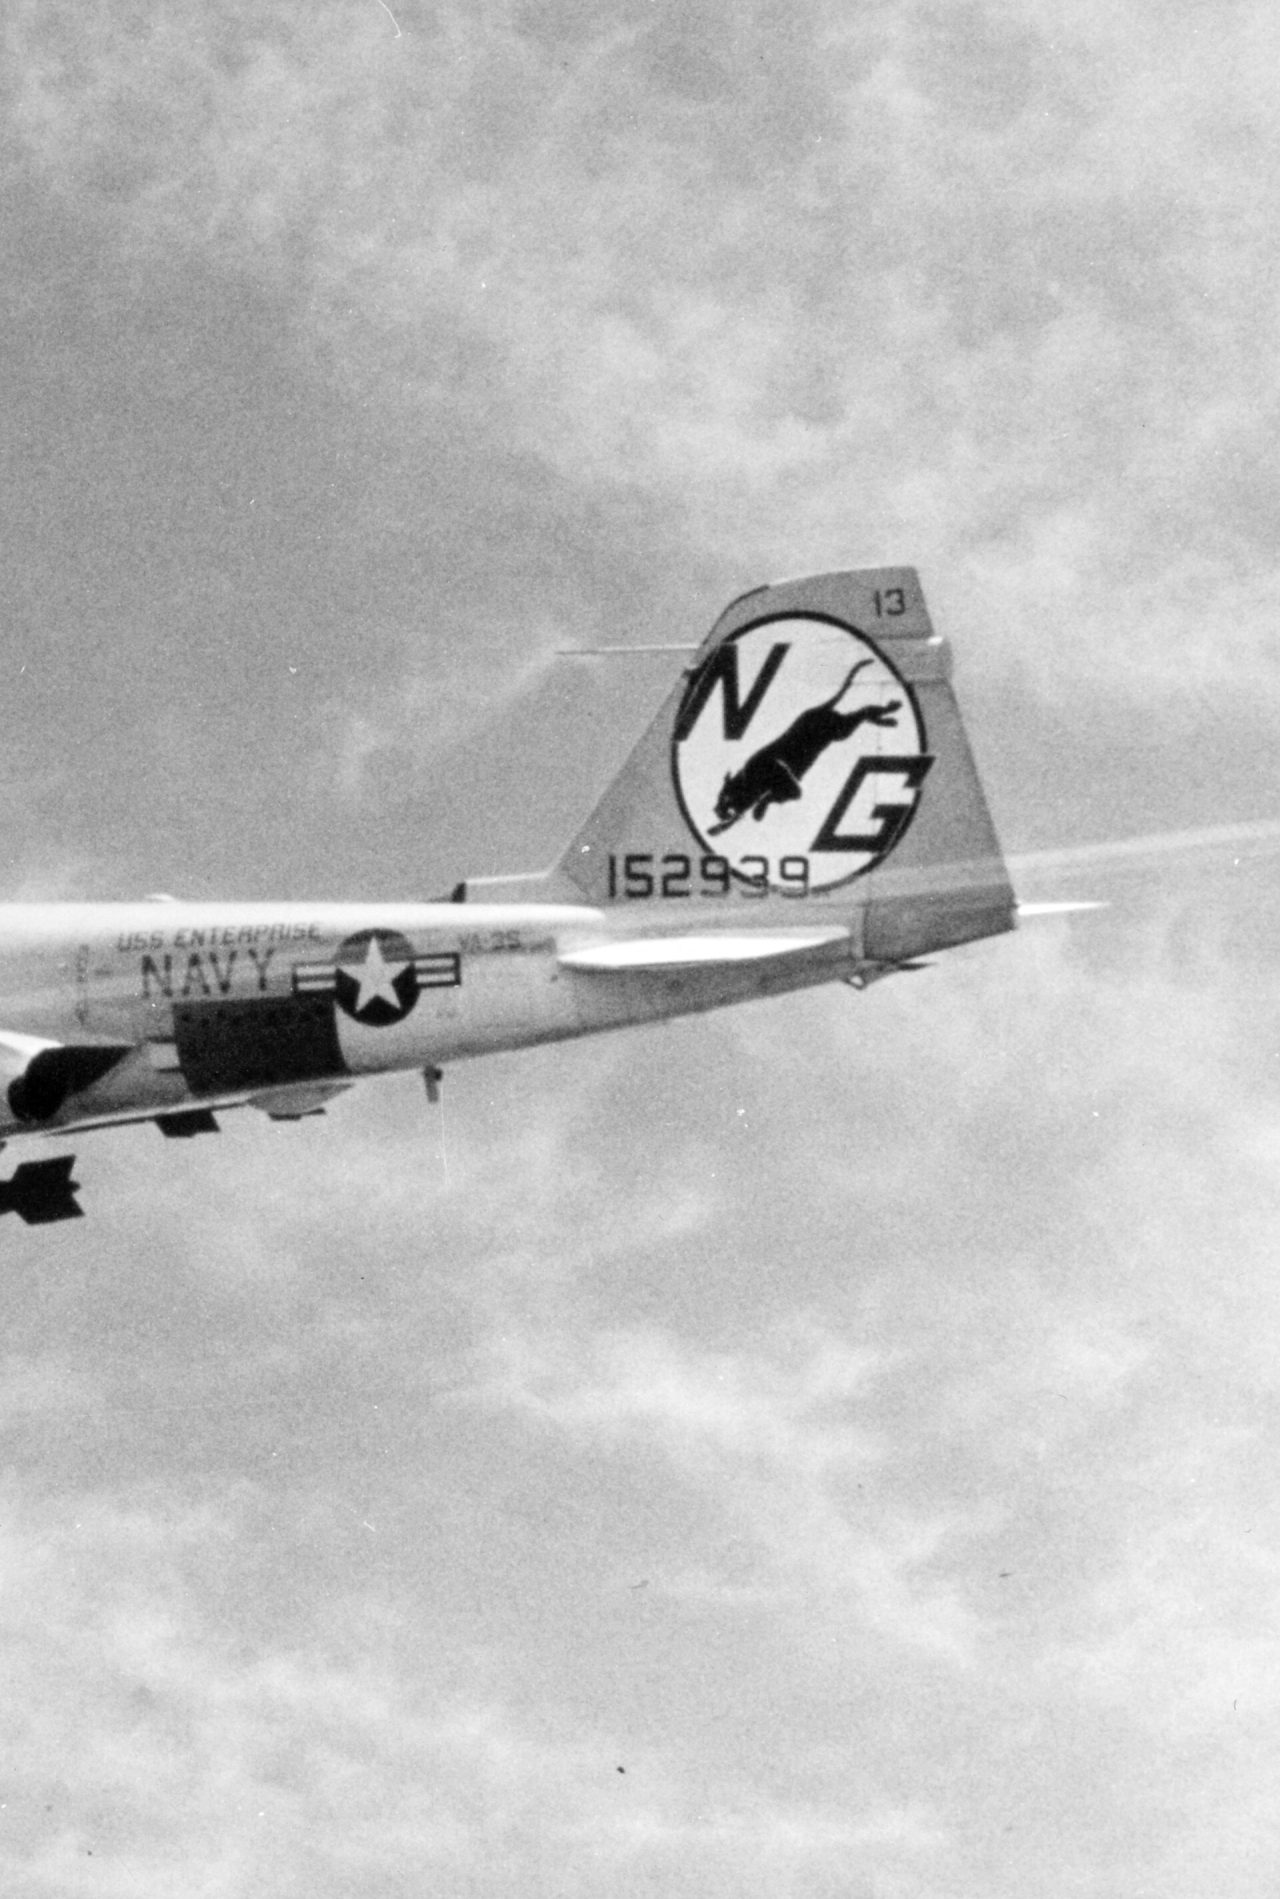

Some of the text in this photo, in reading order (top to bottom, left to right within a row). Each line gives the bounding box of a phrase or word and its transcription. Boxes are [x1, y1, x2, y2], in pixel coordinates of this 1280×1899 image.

[874, 588, 905, 618] 13
[674, 642, 791, 742] N
[809, 755, 936, 852] G
[609, 855, 809, 899] 152939
[118, 922, 320, 951] USS ENTERPRISE
[141, 949, 273, 998] NAVY
